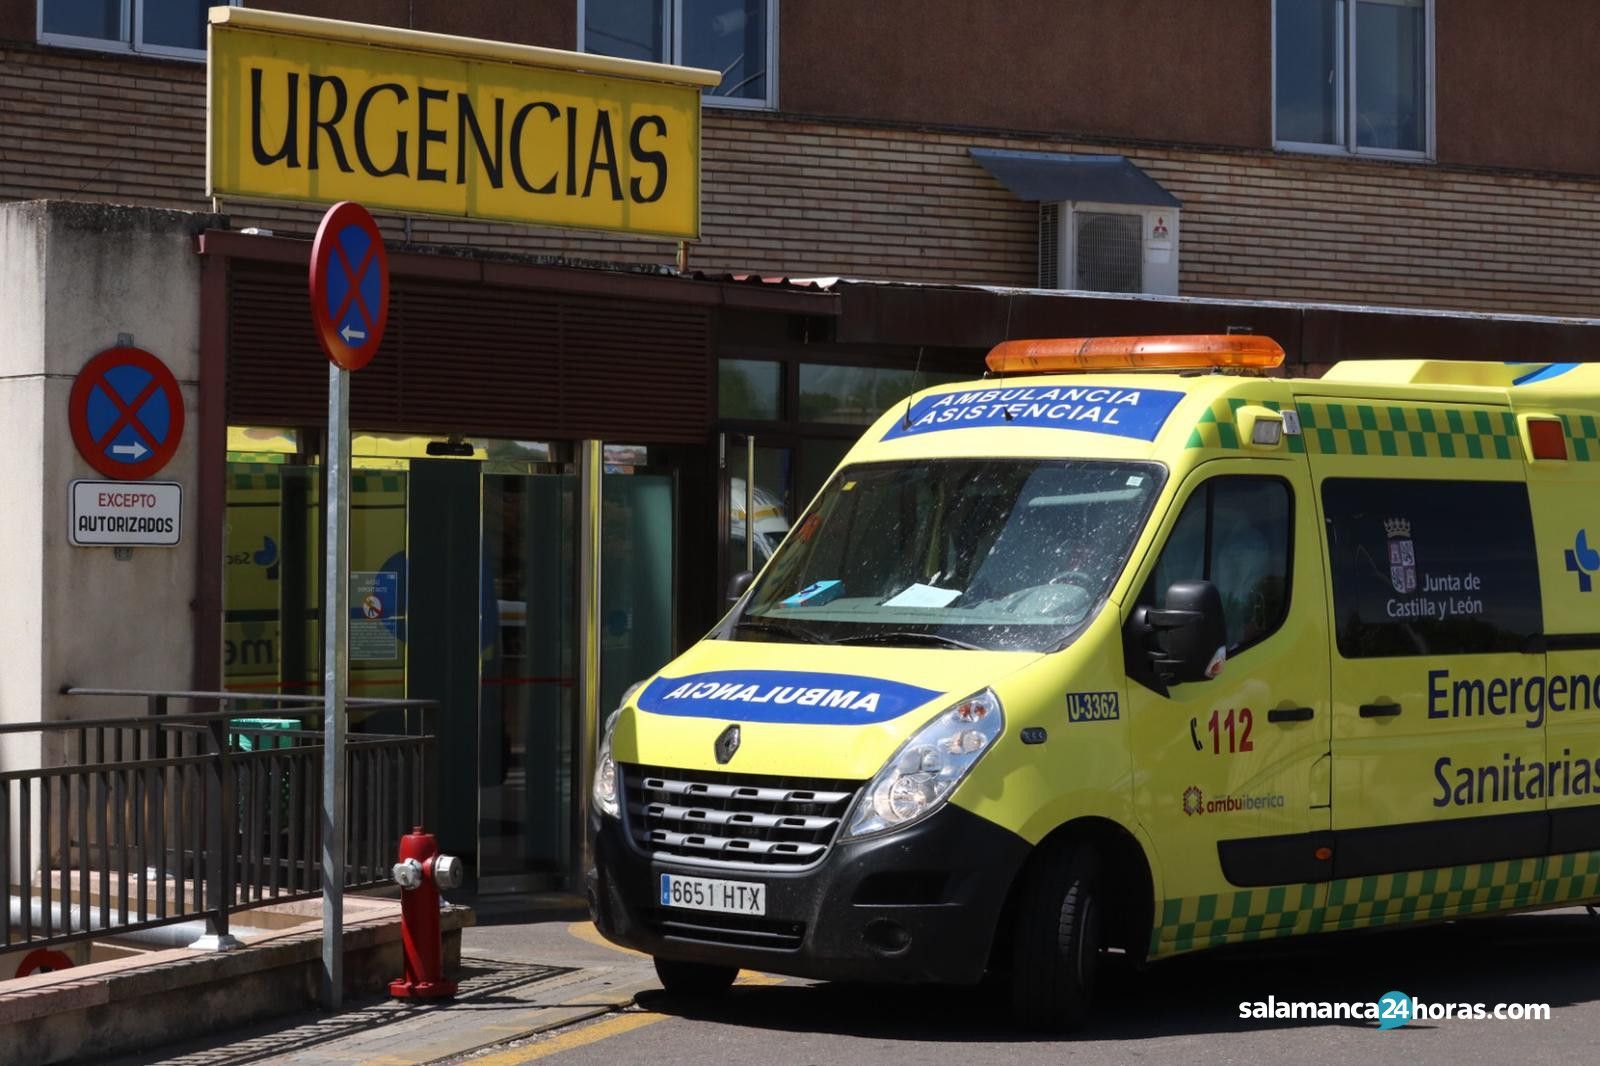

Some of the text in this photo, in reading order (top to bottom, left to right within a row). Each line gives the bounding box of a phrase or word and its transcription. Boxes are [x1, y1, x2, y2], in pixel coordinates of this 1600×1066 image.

[250, 67, 669, 205] URGENCIAS
[931, 388, 1141, 408] AMBULANCIA
[914, 403, 1121, 426] ASISTENCIAL
[97, 493, 157, 508] EXCEPTO
[79, 515, 174, 533] AUTORIZADOS
[1423, 572, 1481, 592] Junta de
[1386, 596, 1483, 621] Castilla y León
[1069, 693, 1119, 721] U-3362
[1208, 707, 1254, 755] 112
[1207, 794, 1285, 813] ambuiberica
[673, 880, 760, 911] 6651 HTX
